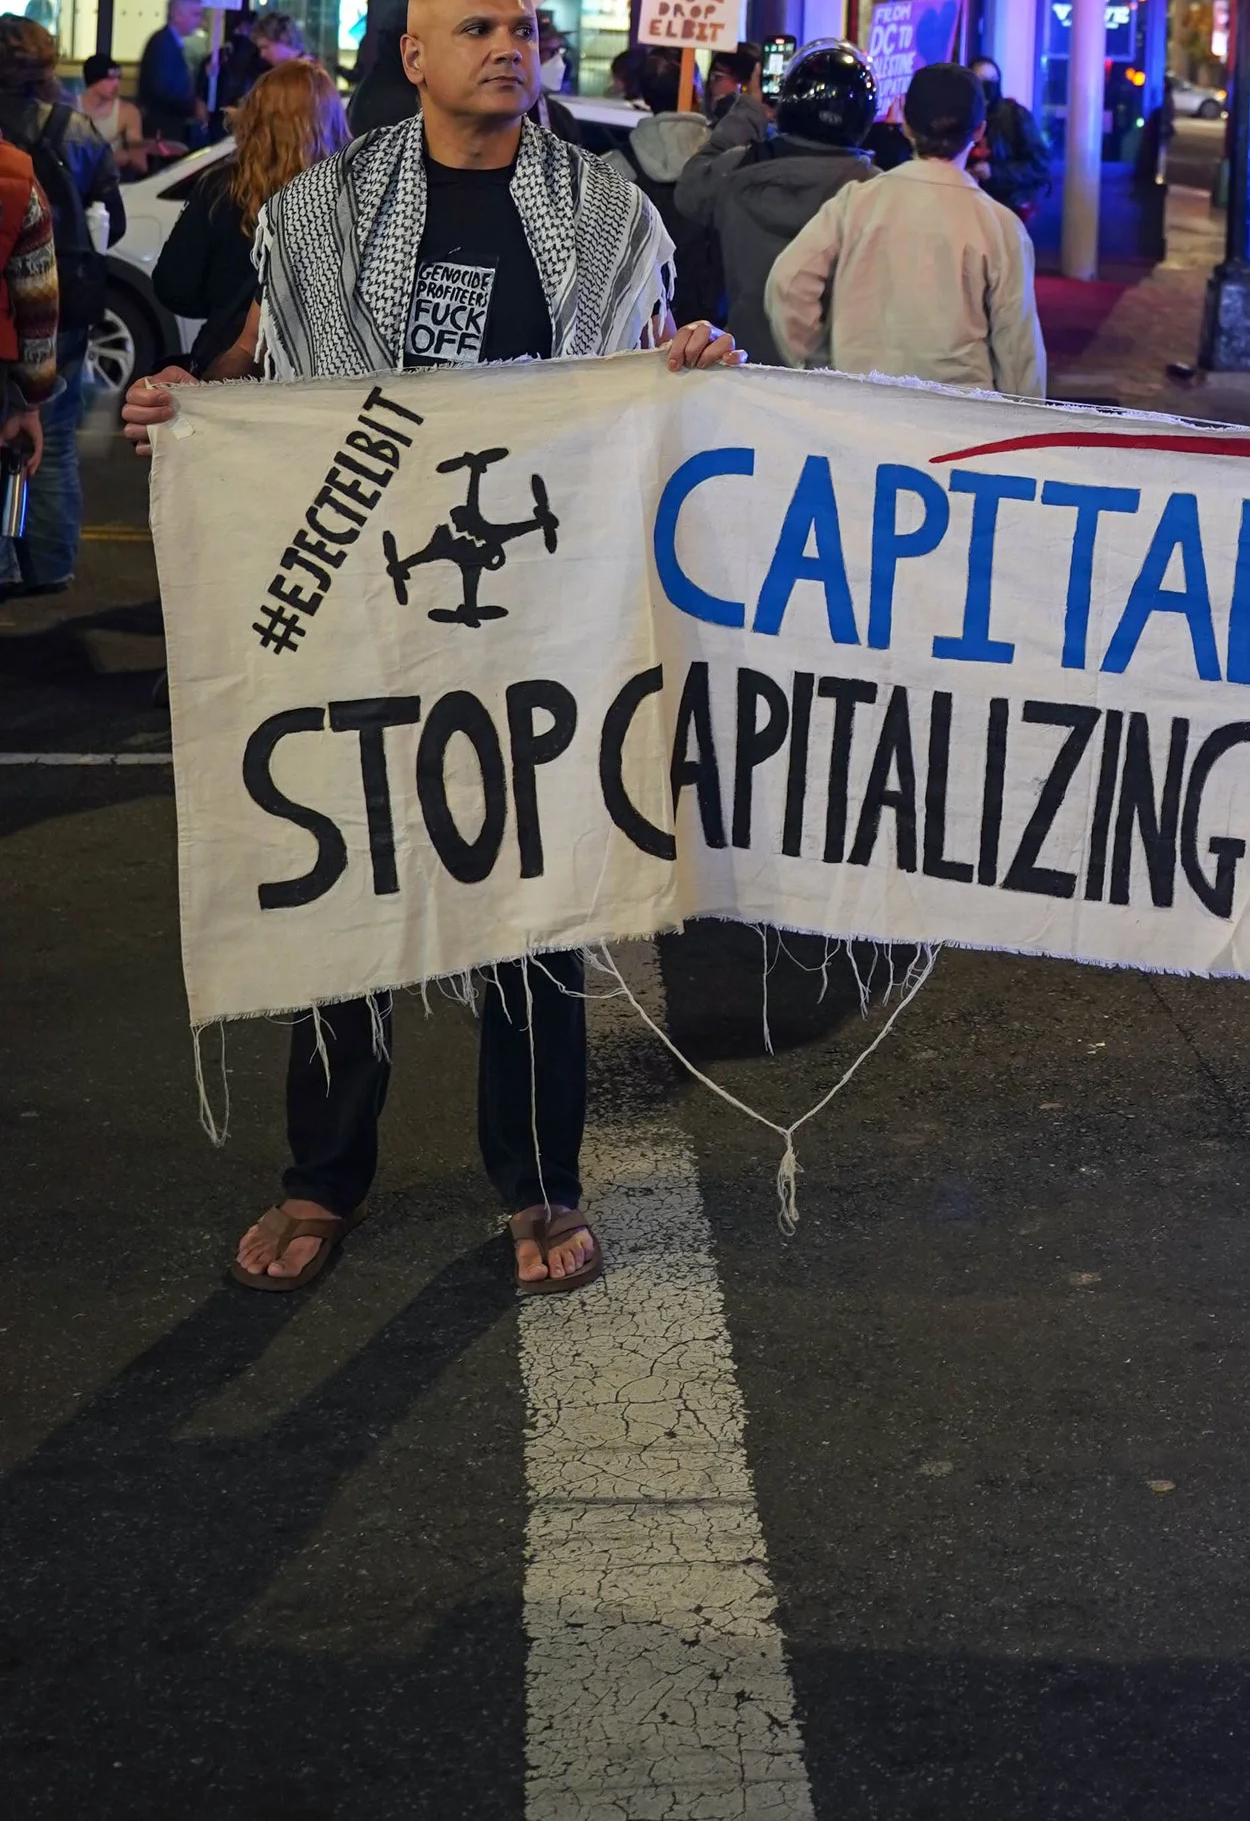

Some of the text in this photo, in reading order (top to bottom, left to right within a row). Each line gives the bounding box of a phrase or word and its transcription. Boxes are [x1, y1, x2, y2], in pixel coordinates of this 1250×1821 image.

[658, 2, 717, 20] DROP
[874, 4, 912, 25] FROM
[648, 19, 725, 42] ELBIT
[869, 23, 897, 57] DC
[420, 264, 492, 292] GENOCIDE
[416, 280, 489, 308] PROFITEERS
[414, 298, 486, 334] FUCK
[411, 324, 481, 355] OFF
[252, 386, 425, 656] #EJECTELBIT
[242, 679, 577, 910] STOP
